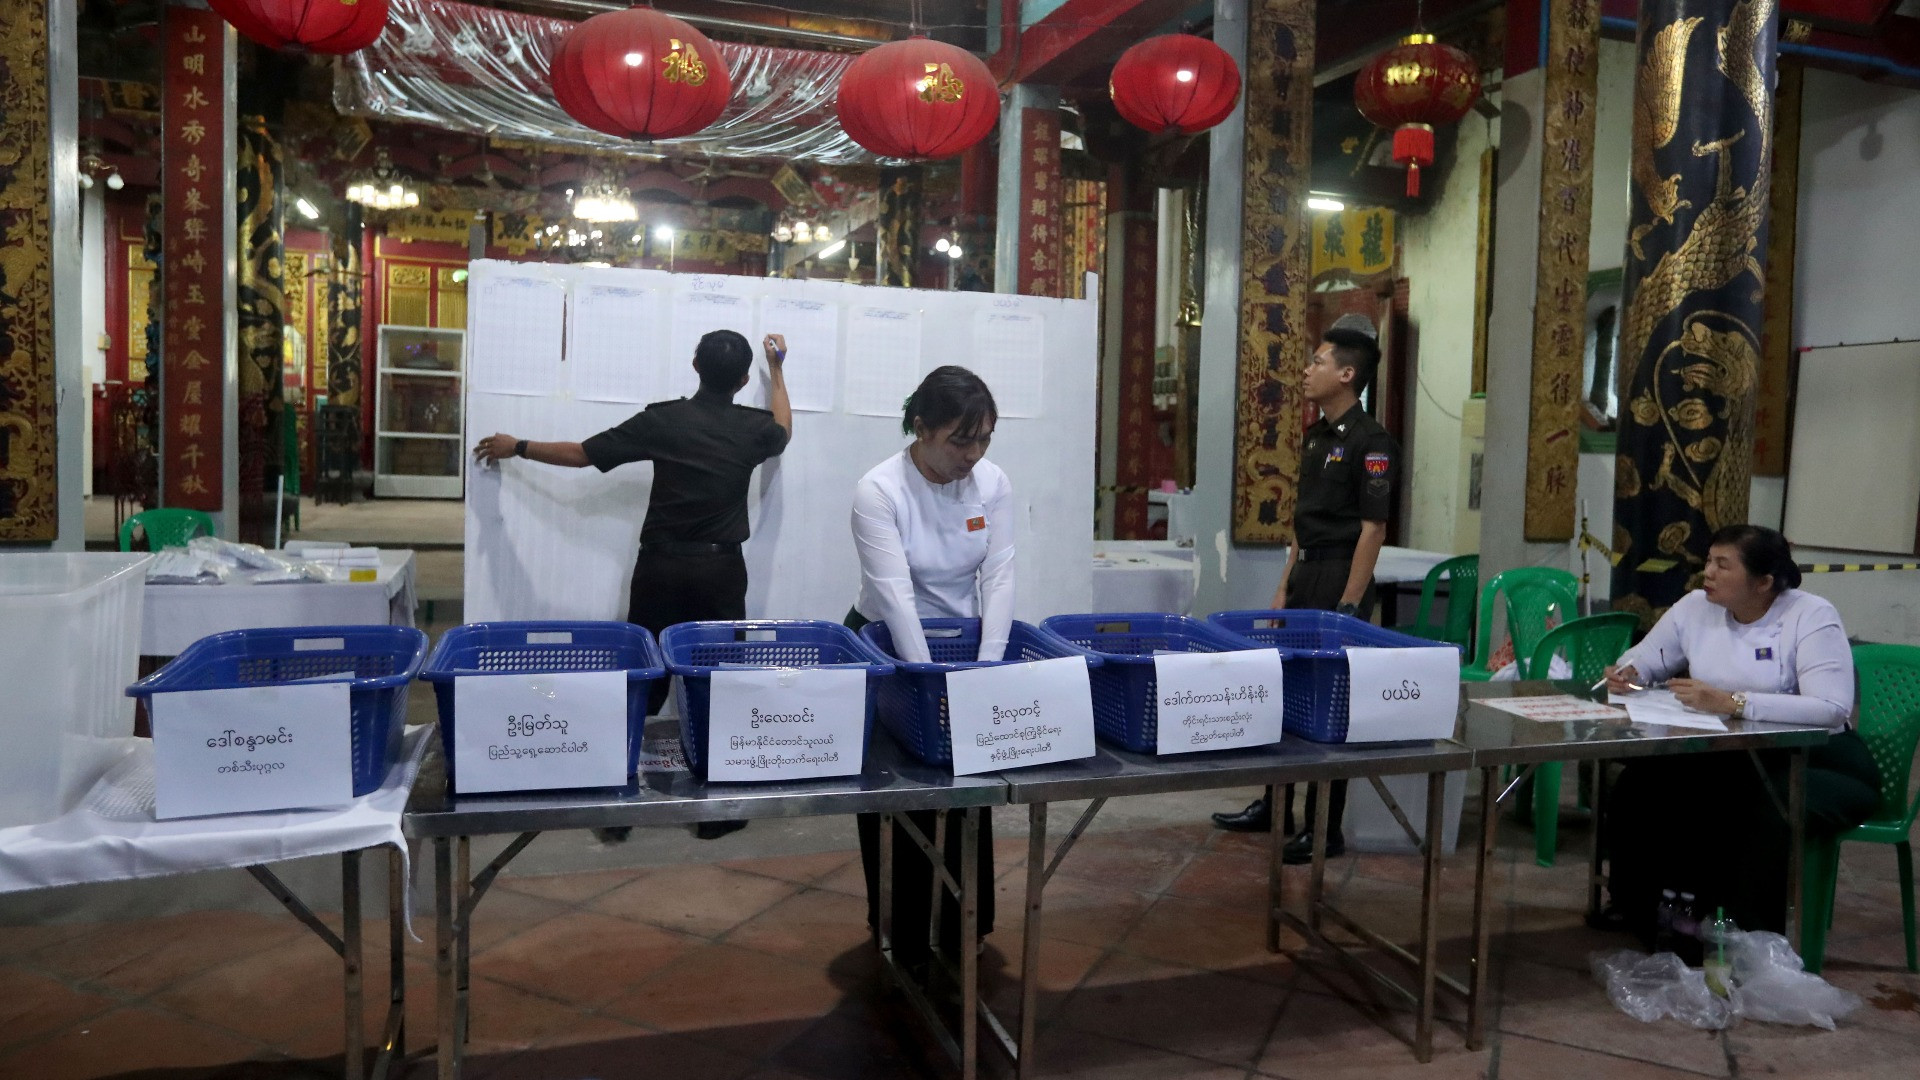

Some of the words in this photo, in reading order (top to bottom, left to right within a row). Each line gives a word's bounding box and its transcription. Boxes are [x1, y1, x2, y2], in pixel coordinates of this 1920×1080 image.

[1163, 685, 1269, 706] ဒေါက်တာသန်းဟိန်းစိုး
[1382, 679, 1420, 700] ပယ်မဲ
[751, 708, 815, 728] ဦးလေးဝင်း
[992, 700, 1041, 724] ဦးလှတင့်
[507, 714, 568, 737] ဦးမြတ်သူ
[207, 726, 293, 752] ဒေါ်စန္ဒာမင်း
[730, 734, 834, 750] မြန်မာနိုင်ငံတောင်သူလယ်
[217, 760, 285, 775] တစ်သီးပုဂ္ဂလ
